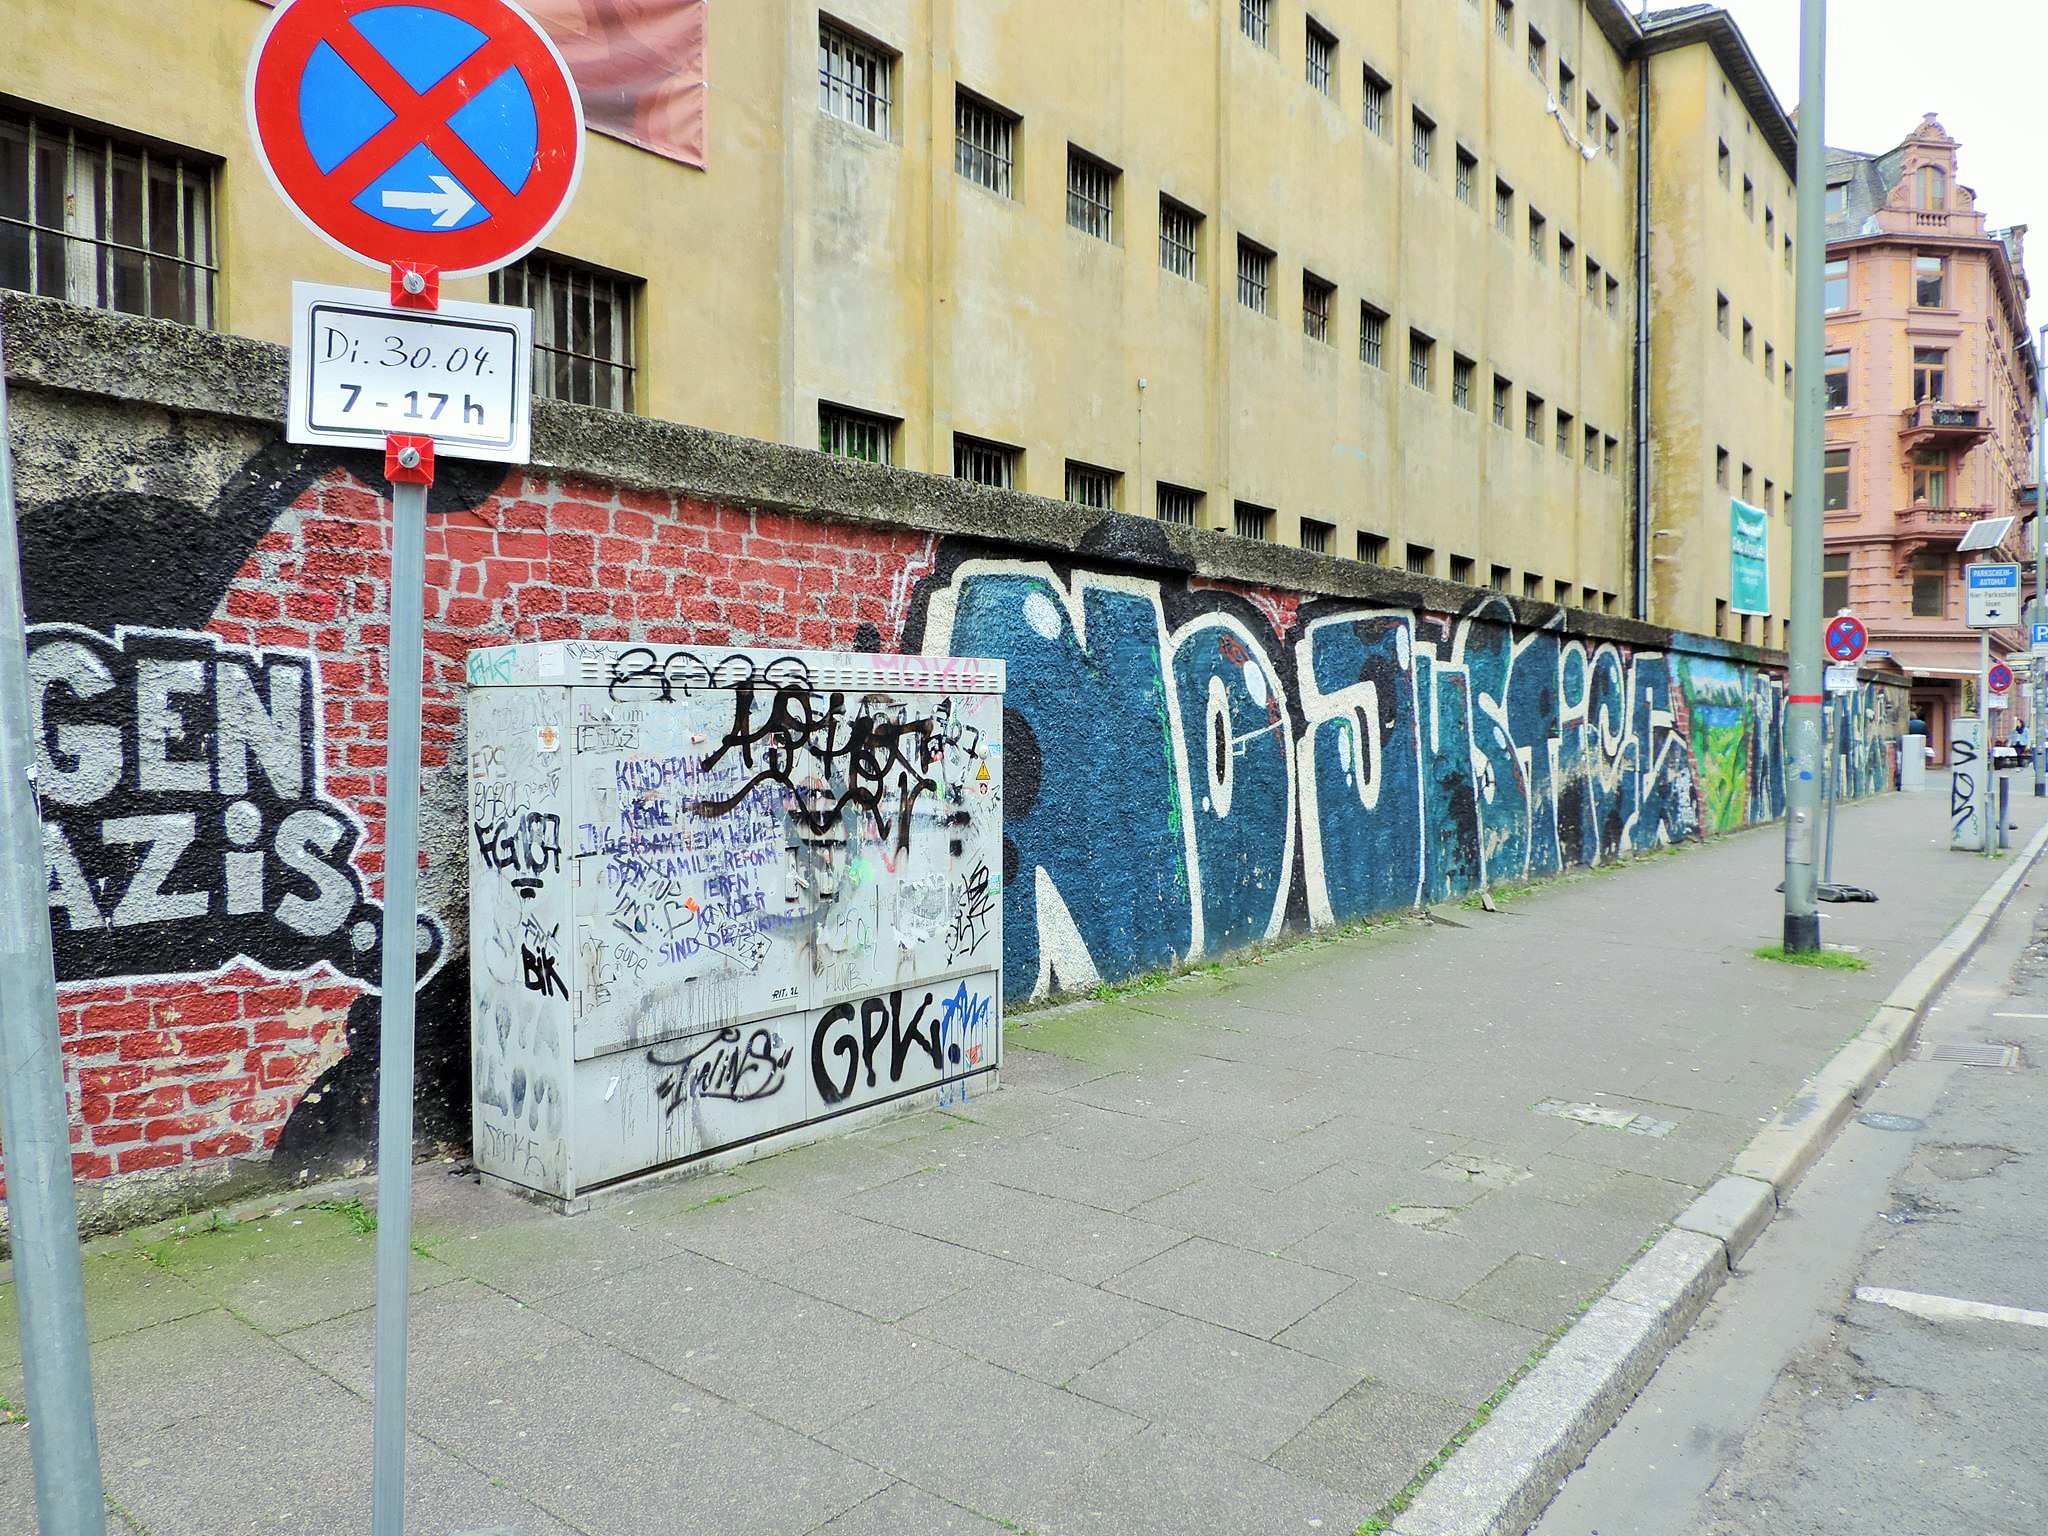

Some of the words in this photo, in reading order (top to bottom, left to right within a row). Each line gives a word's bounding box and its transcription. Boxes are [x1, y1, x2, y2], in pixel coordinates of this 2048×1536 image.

[319, 327, 369, 364] Di.
[379, 336, 494, 376] 30.04.
[340, 384, 362, 412] 7
[404, 390, 449, 420] 17
[463, 394, 484, 425] h
